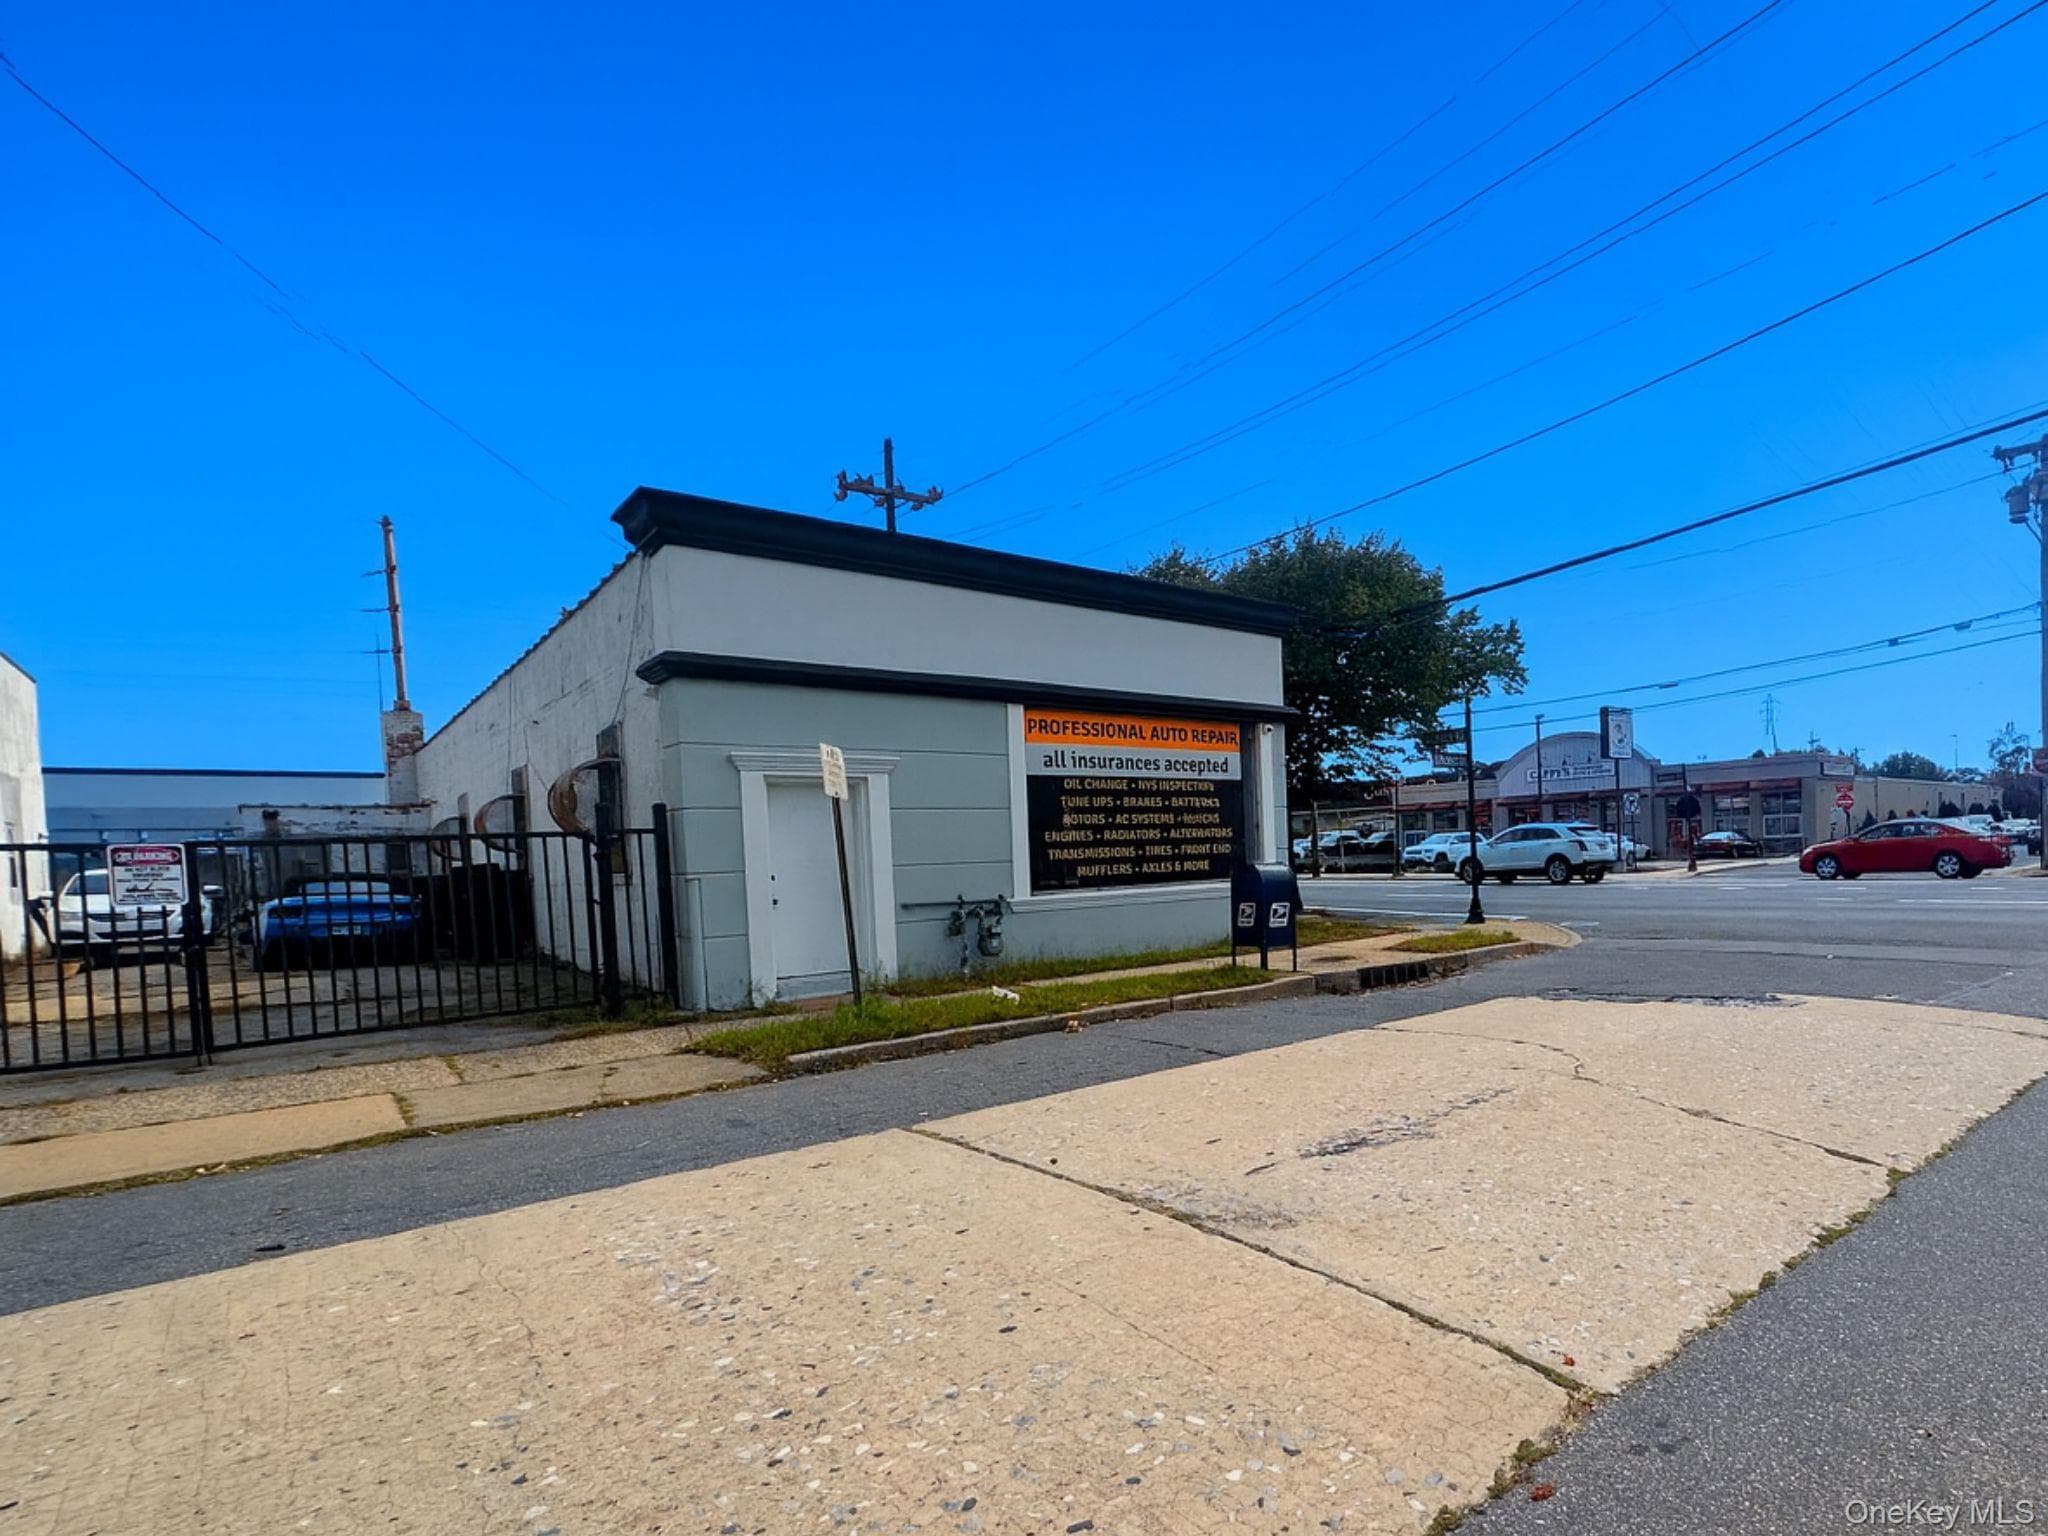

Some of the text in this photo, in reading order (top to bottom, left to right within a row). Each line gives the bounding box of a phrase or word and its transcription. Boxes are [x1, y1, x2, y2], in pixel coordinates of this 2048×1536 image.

[1027, 718, 1239, 745] PROFESSIONAL AUTO REPAIR
[1043, 750, 1229, 775] all insurances accepted
[1063, 778, 1082, 789] OIL
[1084, 779, 1129, 790] CHANGE
[1060, 796, 1090, 808] TUNE
[1092, 796, 1114, 807] UPS
[1122, 797, 1162, 807] BRAKES
[1115, 814, 1129, 824] AC
[1131, 813, 1174, 824] SYSTEMS
[1044, 830, 1094, 842] ENGINES
[1103, 829, 1161, 840] RADIATORS
[1047, 846, 1137, 861] TRANSMISSIONS
[1145, 845, 1173, 856] TIRES
[1213, 843, 1232, 854] END
[1077, 859, 1210, 877] MUFFLERS AXLES & MORE
